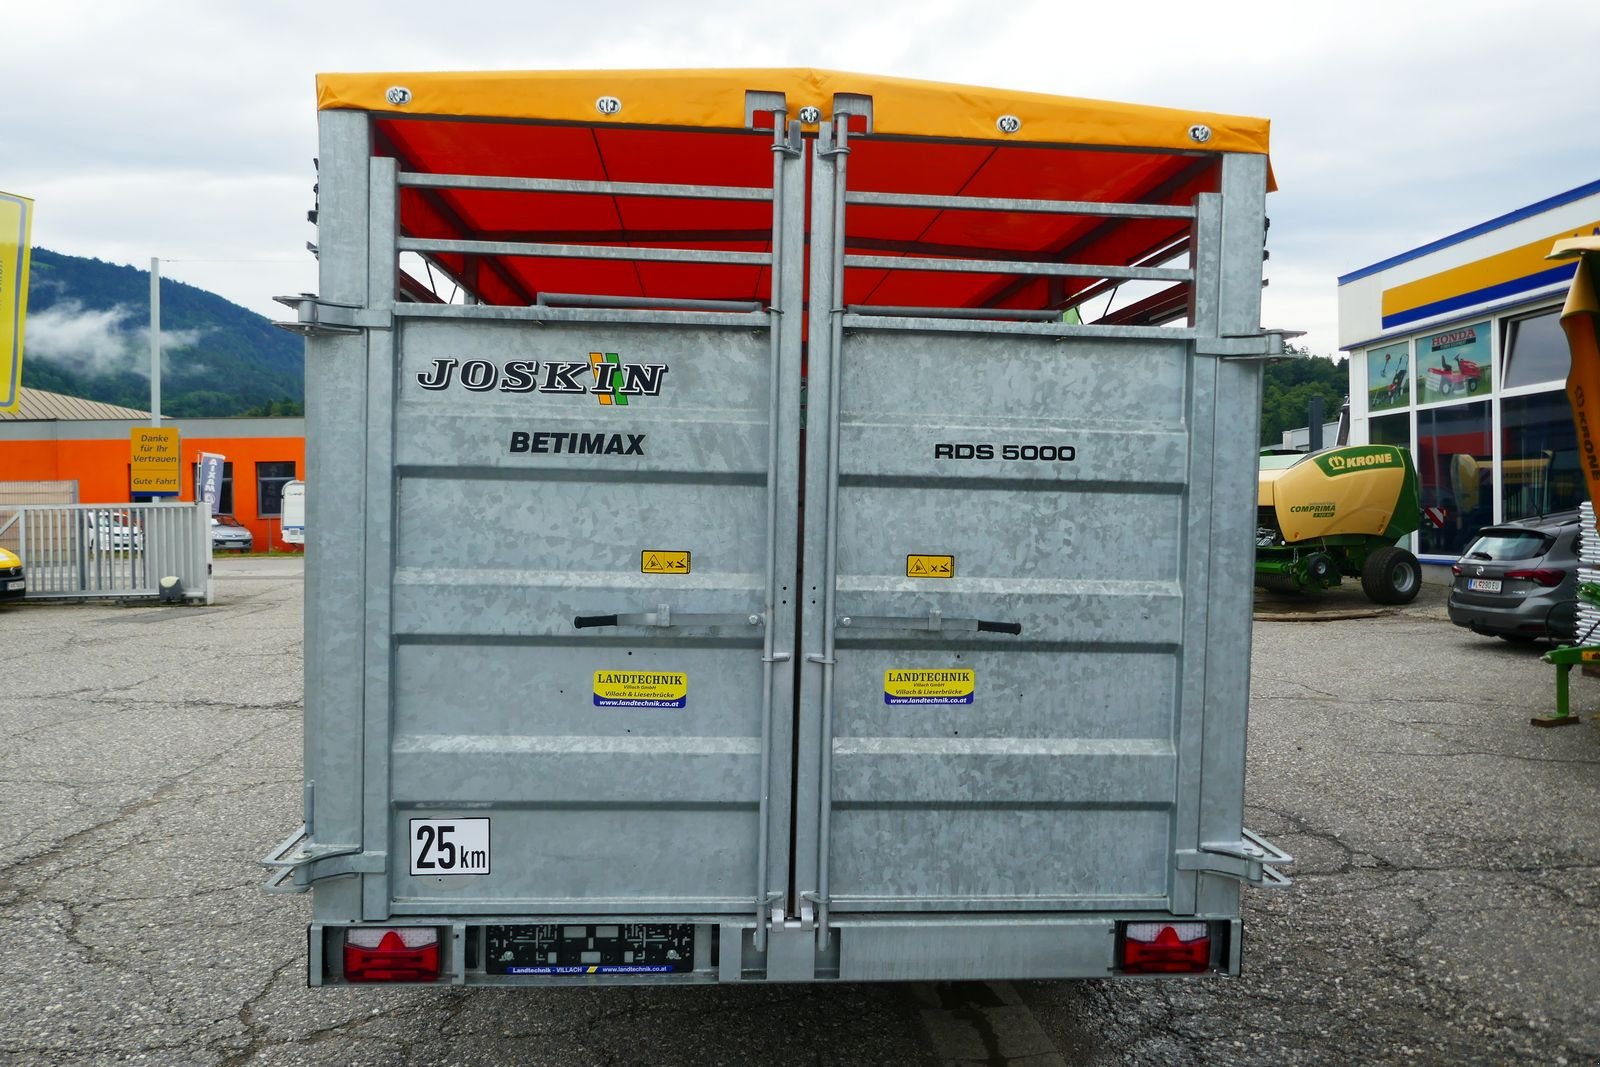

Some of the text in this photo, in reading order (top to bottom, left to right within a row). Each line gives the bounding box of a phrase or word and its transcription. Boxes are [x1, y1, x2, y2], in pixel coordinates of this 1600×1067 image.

[1432, 329, 1476, 345] HONDA
[416, 358, 669, 396] JOSKIN
[141, 434, 169, 442] Danke
[510, 431, 646, 456] BETIMAX
[140, 444, 169, 453] für Ihr
[934, 443, 1076, 462] RDS 5000
[133, 455, 177, 463] Vertrauen
[1346, 453, 1393, 468] KRONE
[204, 458, 218, 492] AIXAM
[1290, 504, 1336, 513] COMPRIMA
[598, 674, 683, 685] LANDTECHNIK
[888, 672, 970, 682] LANDTECHNIK
[599, 699, 679, 707] www.landtechnik.co.at
[416, 825, 486, 869] 25 km
[602, 965, 667, 973] www.landtechnik.co.at
